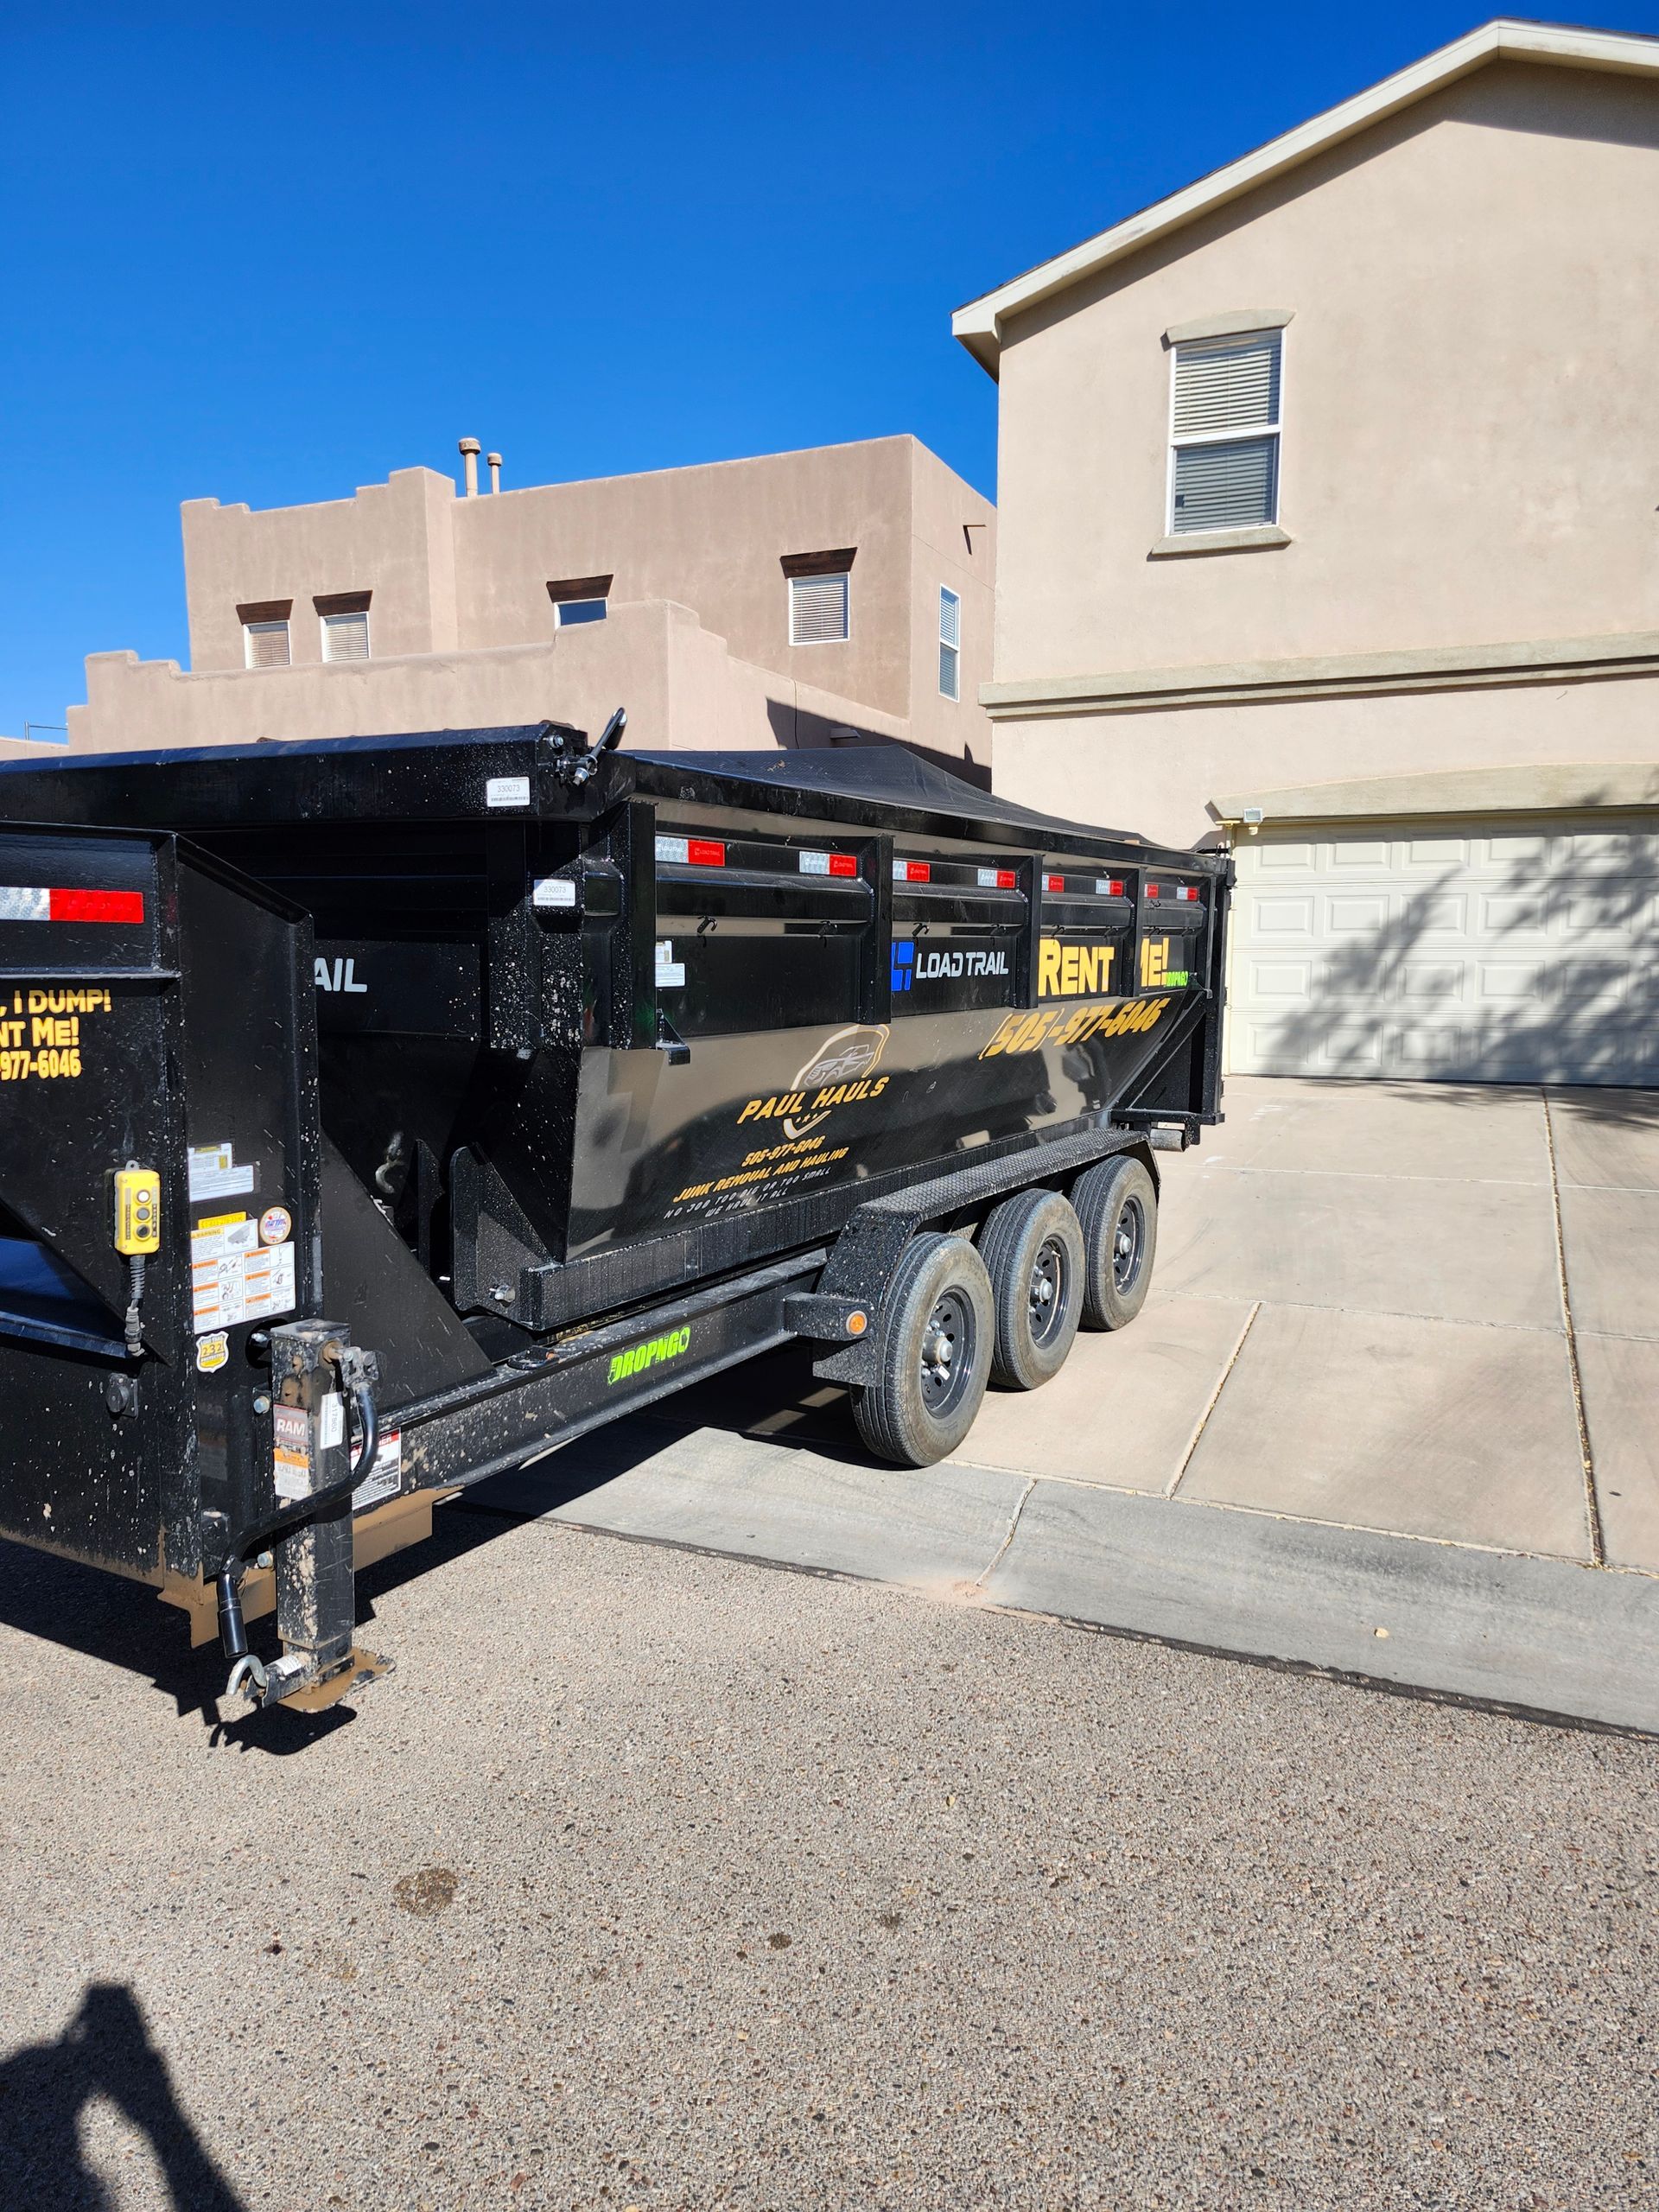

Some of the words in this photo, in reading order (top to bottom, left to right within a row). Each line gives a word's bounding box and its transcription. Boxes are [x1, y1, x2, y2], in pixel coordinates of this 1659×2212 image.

[497, 785, 520, 793] 330073
[1038, 938, 1115, 996] RENT
[14, 989, 22, 1014] I
[28, 988, 111, 1014] DUMP!
[32, 1016, 79, 1047] ME!
[978, 997, 1171, 1061] (505)-977-6046
[736, 1090, 806, 1125] PAUL
[810, 1076, 890, 1109] HAULS
[741, 1135, 826, 1167] 505-977-6046
[664, 1207, 683, 1219] NO
[715, 1192, 737, 1205] TOO
[780, 1175, 800, 1187] TOO
[802, 1166, 831, 1181] SMALL
[673, 1180, 715, 1203] JUNK
[712, 1166, 772, 1192] REMOVAL
[772, 1159, 801, 1176] AND
[799, 1147, 849, 1168] HAULING
[704, 1205, 723, 1217] WE
[756, 1192, 769, 1203] IT
[769, 1188, 788, 1199] ALL
[607, 1325, 690, 1386] DROPNGO
[276, 1418, 306, 1437] RAM
